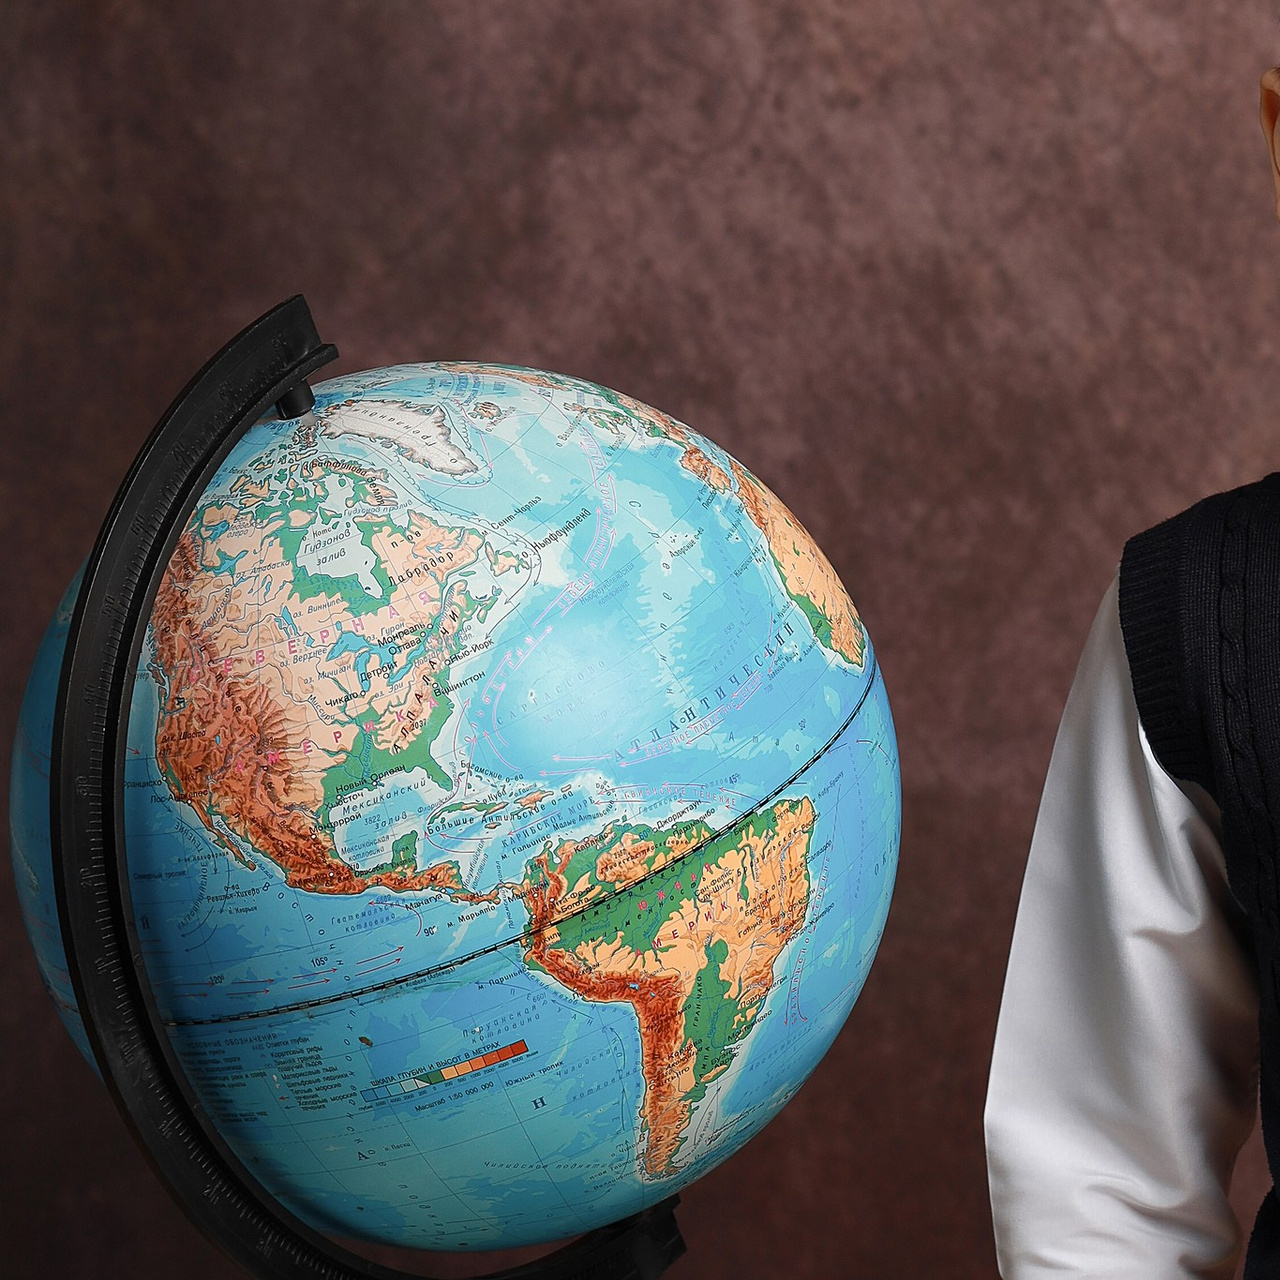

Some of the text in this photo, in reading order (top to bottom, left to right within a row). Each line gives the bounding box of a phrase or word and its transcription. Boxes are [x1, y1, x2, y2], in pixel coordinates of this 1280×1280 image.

[303, 529, 351, 554] Гудзонов
[532, 508, 591, 553] Ньюфаундленд
[317, 548, 346, 567] залив
[388, 551, 454, 586] Лабрадор
[377, 623, 425, 648] Монреаль
[381, 621, 405, 636] Гурон
[388, 636, 422, 656] Оттава
[360, 660, 398, 683] Детройт
[434, 671, 486, 696] Вашингтон
[325, 693, 358, 707] Чикаго
[335, 764, 406, 794] Новый Орлеан
[342, 778, 428, 816] Мексиканский
[374, 812, 408, 830] залив
[427, 791, 574, 835] Большие Антильские о-ва
[502, 796, 595, 848] КАРИБСКОЕ МОРЕ
[405, 893, 443, 912] Манагуа
[457, 905, 496, 923] Марьято
[370, 1075, 396, 1087] ШКАЛА
[400, 1066, 426, 1080] ГЛУБИН
[435, 1056, 462, 1068] ВЫСОТ
[472, 1041, 501, 1056] МЕТРАХ
[505, 1060, 565, 1087] Южный тропик
[414, 1081, 494, 1112] Масштаб 1:50 000 000
